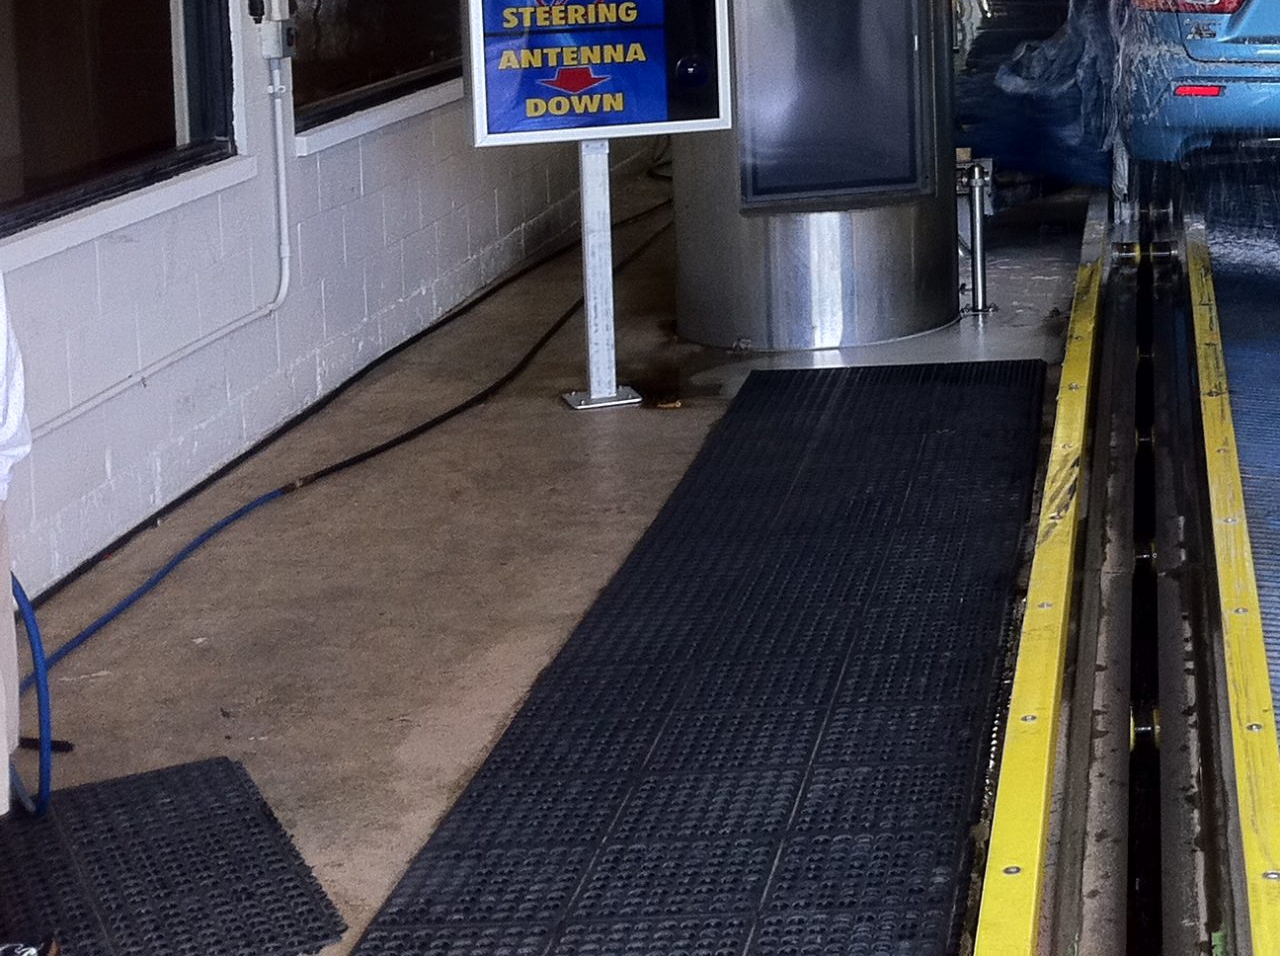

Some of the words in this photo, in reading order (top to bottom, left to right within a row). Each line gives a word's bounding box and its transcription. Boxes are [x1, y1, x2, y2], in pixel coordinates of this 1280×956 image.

[502, 1, 638, 29] STEERING
[498, 43, 646, 70] ANTENNA
[525, 92, 624, 118] DOWN
